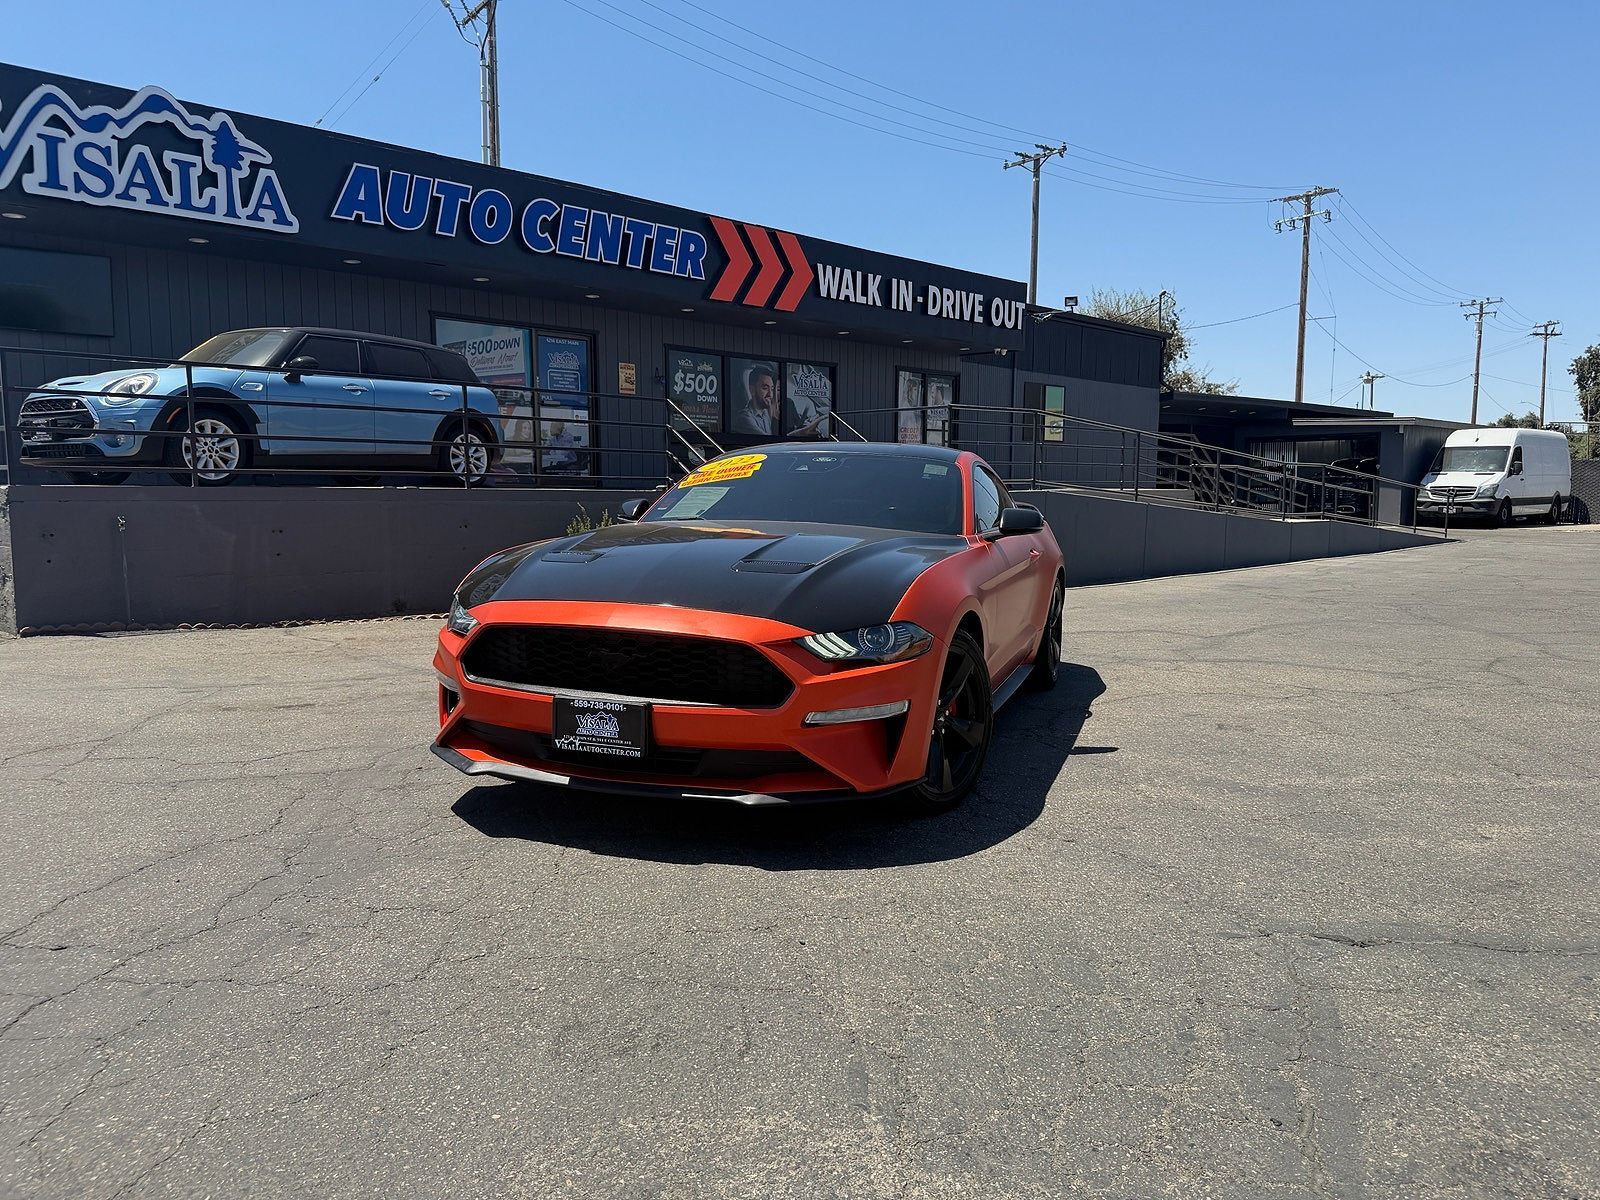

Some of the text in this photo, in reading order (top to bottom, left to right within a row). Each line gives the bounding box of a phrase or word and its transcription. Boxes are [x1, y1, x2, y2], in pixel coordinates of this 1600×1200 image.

[331, 162, 708, 280] AUTO CENTER
[816, 262, 882, 307] WALK
[990, 297, 1026, 330] OUT
[467, 337, 521, 356] $500 DOWN
[673, 369, 718, 395] $500
[792, 370, 828, 390] VISALIA
[697, 395, 718, 403] DOWN
[794, 389, 828, 398] AUTO CENTER
[717, 463, 756, 475] OWNER
[681, 471, 748, 487] CLEAN CARFAX
[576, 712, 619, 731] VISALIA
[576, 728, 619, 738] AUTO CENTER
[555, 737, 641, 758] VISALIAAUTOCENTER.COM
